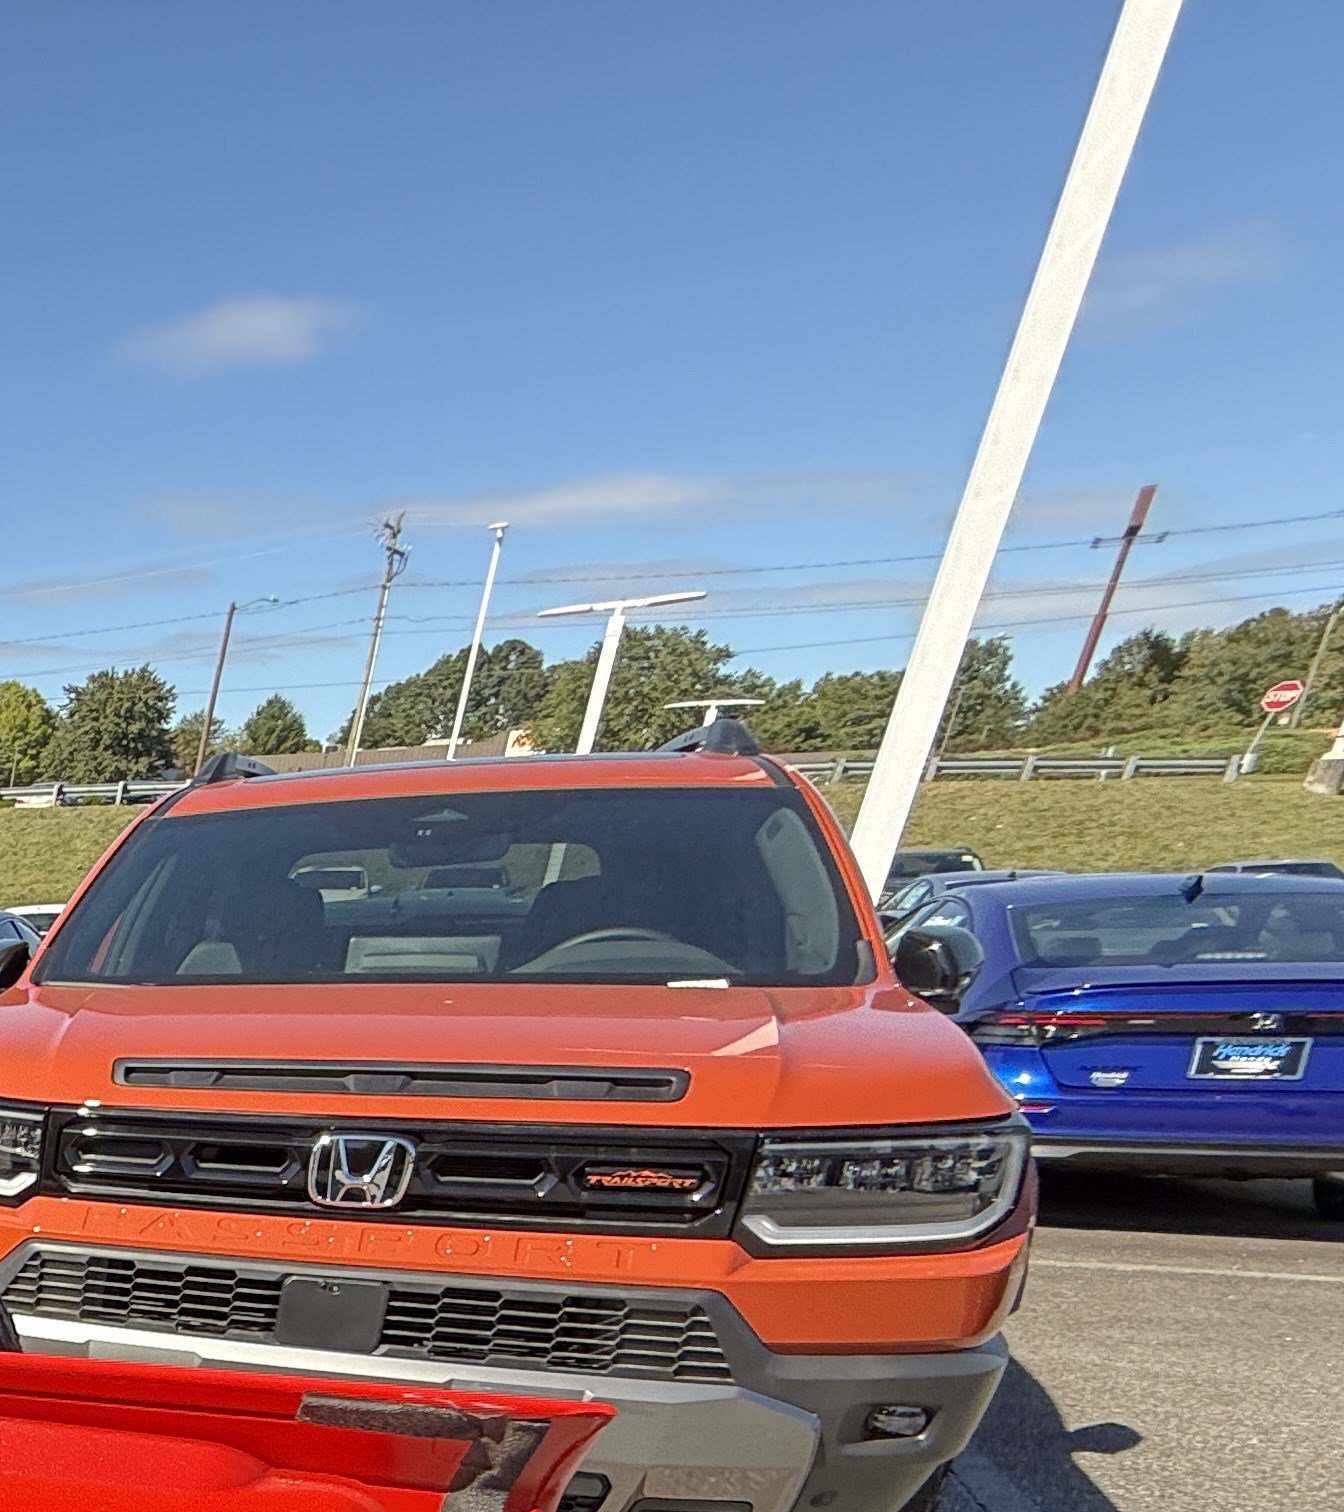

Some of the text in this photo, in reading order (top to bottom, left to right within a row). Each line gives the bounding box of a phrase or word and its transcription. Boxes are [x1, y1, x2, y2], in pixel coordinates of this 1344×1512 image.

[1263, 689, 1300, 702] STOP
[1212, 1044, 1292, 1059] Hendrick
[81, 1203, 660, 1272] PASSPORT
